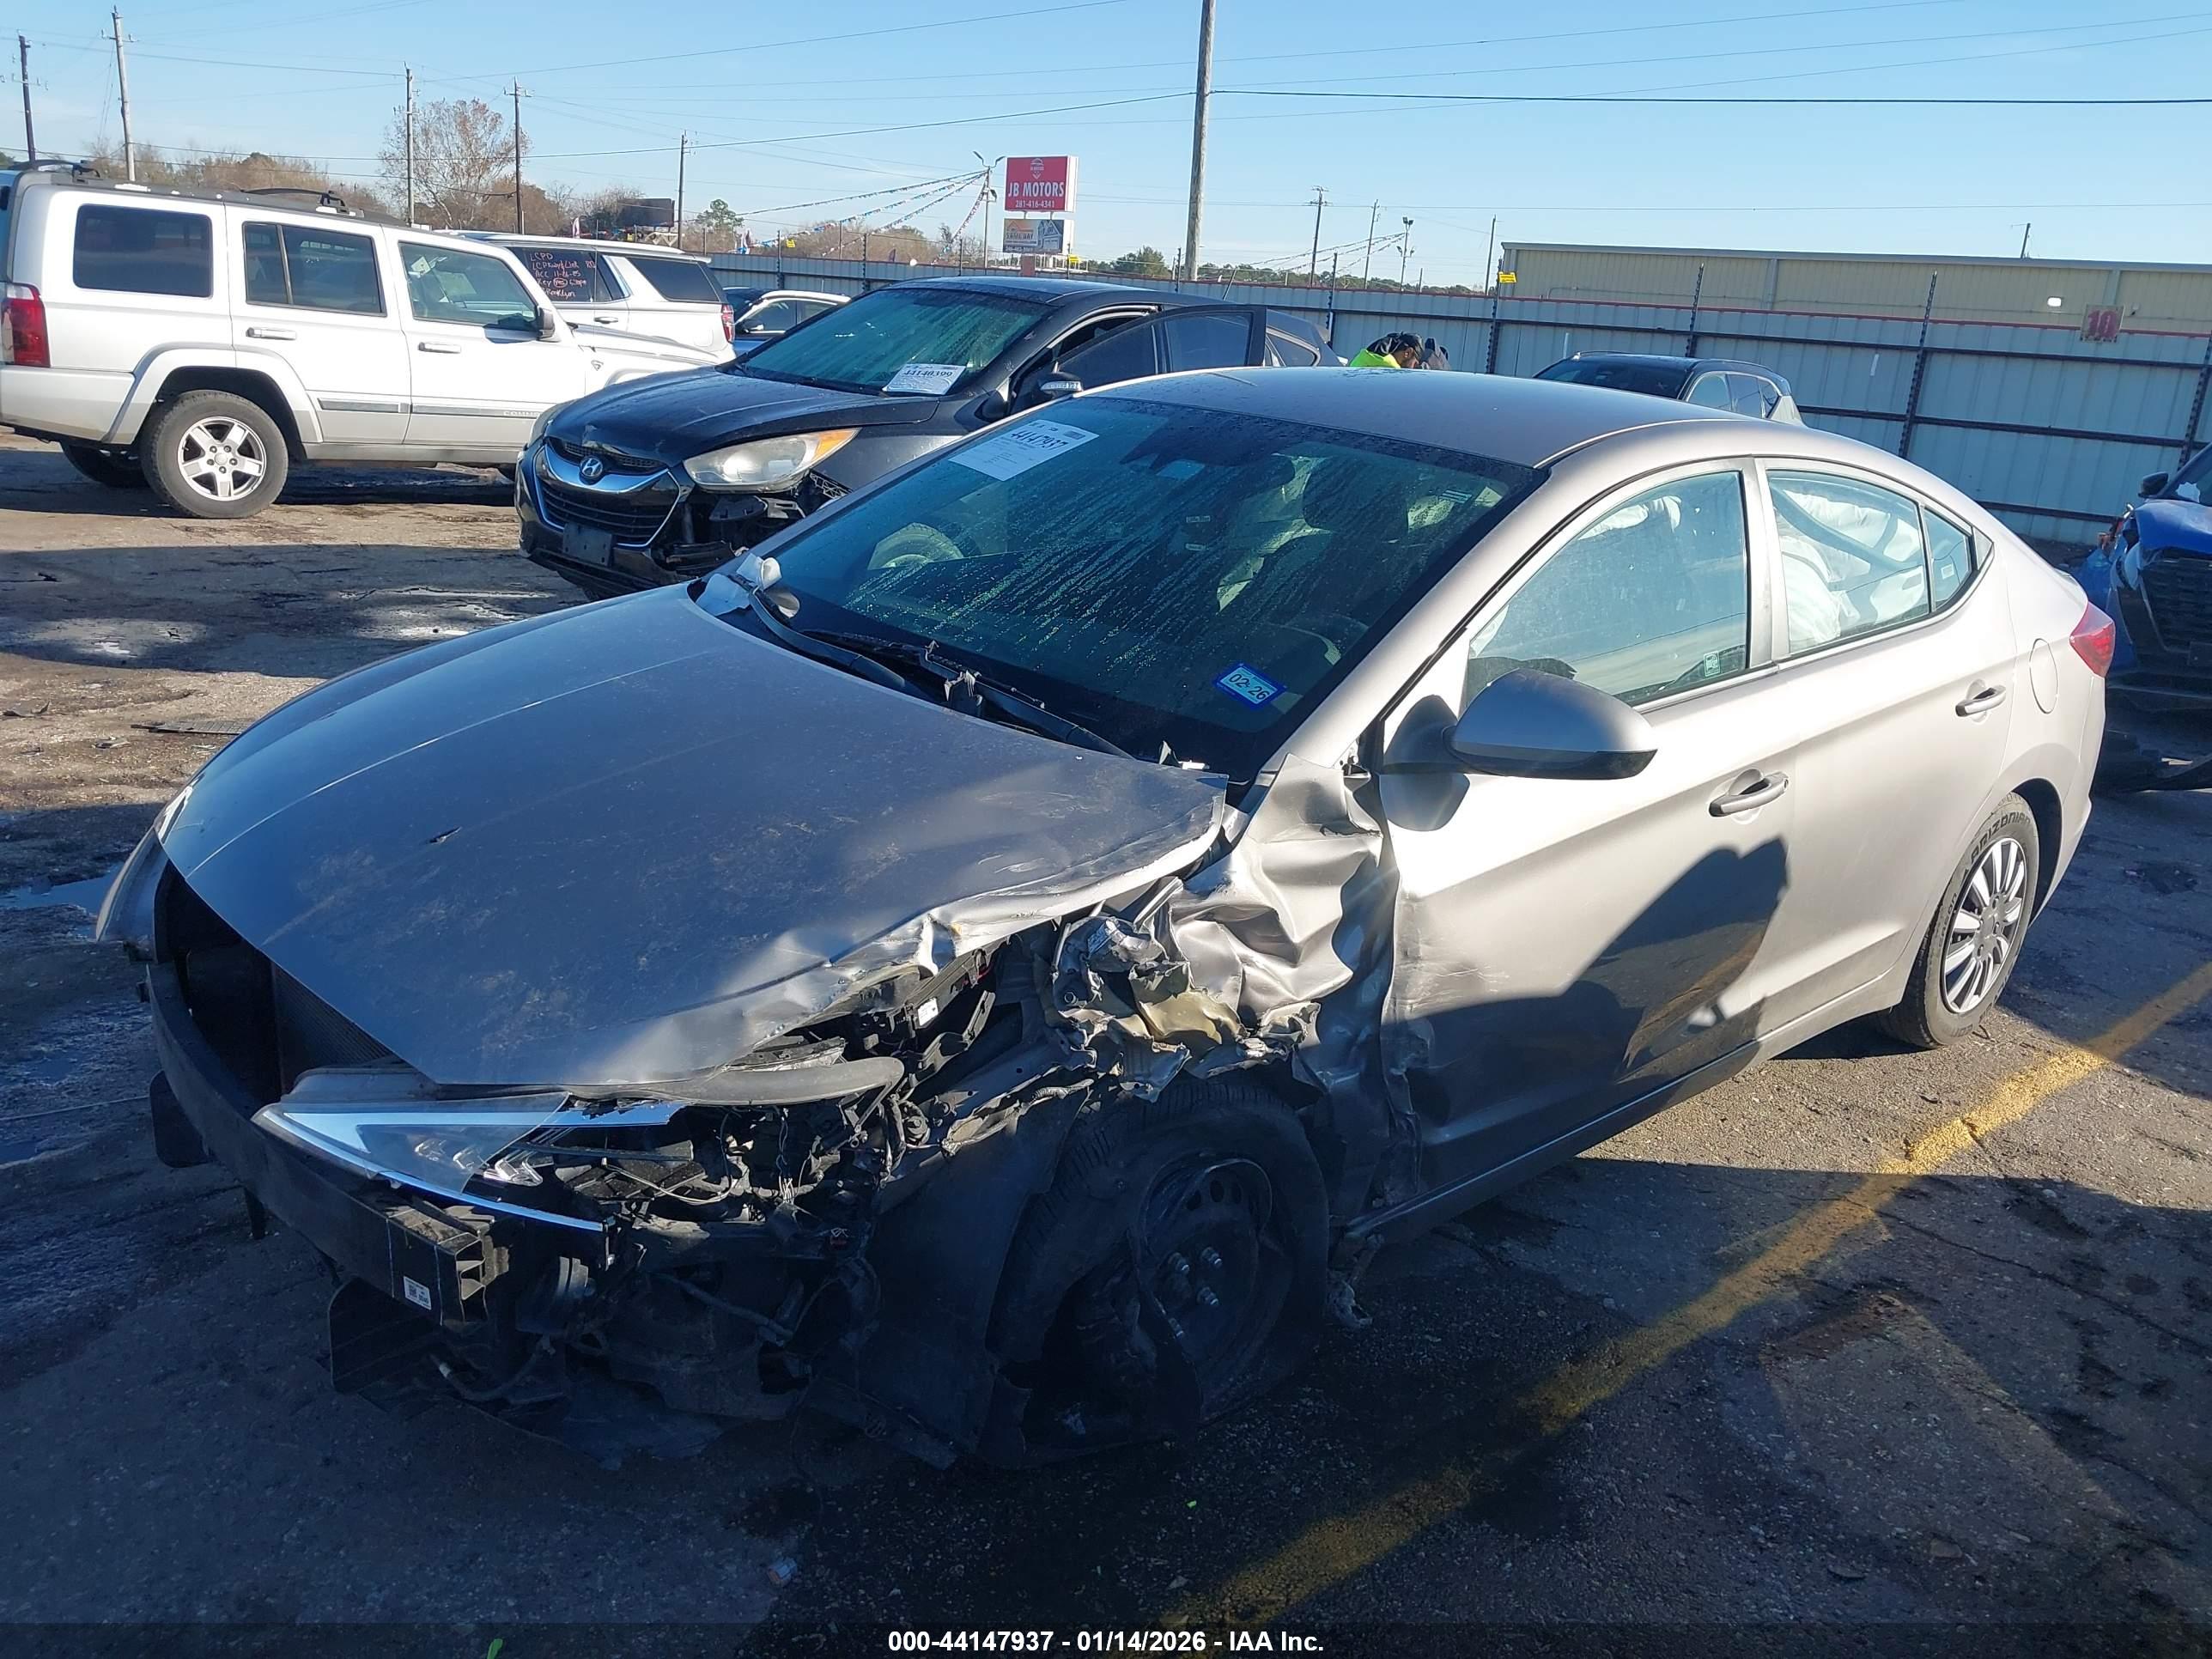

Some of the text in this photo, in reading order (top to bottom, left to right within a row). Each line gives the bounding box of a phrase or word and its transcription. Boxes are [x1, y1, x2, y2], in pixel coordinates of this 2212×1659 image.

[1008, 181, 1065, 198] JB MOTORS
[2087, 309, 2118, 337] 10
[1011, 431, 1069, 451] 44147937
[1248, 686, 1270, 700] 26
